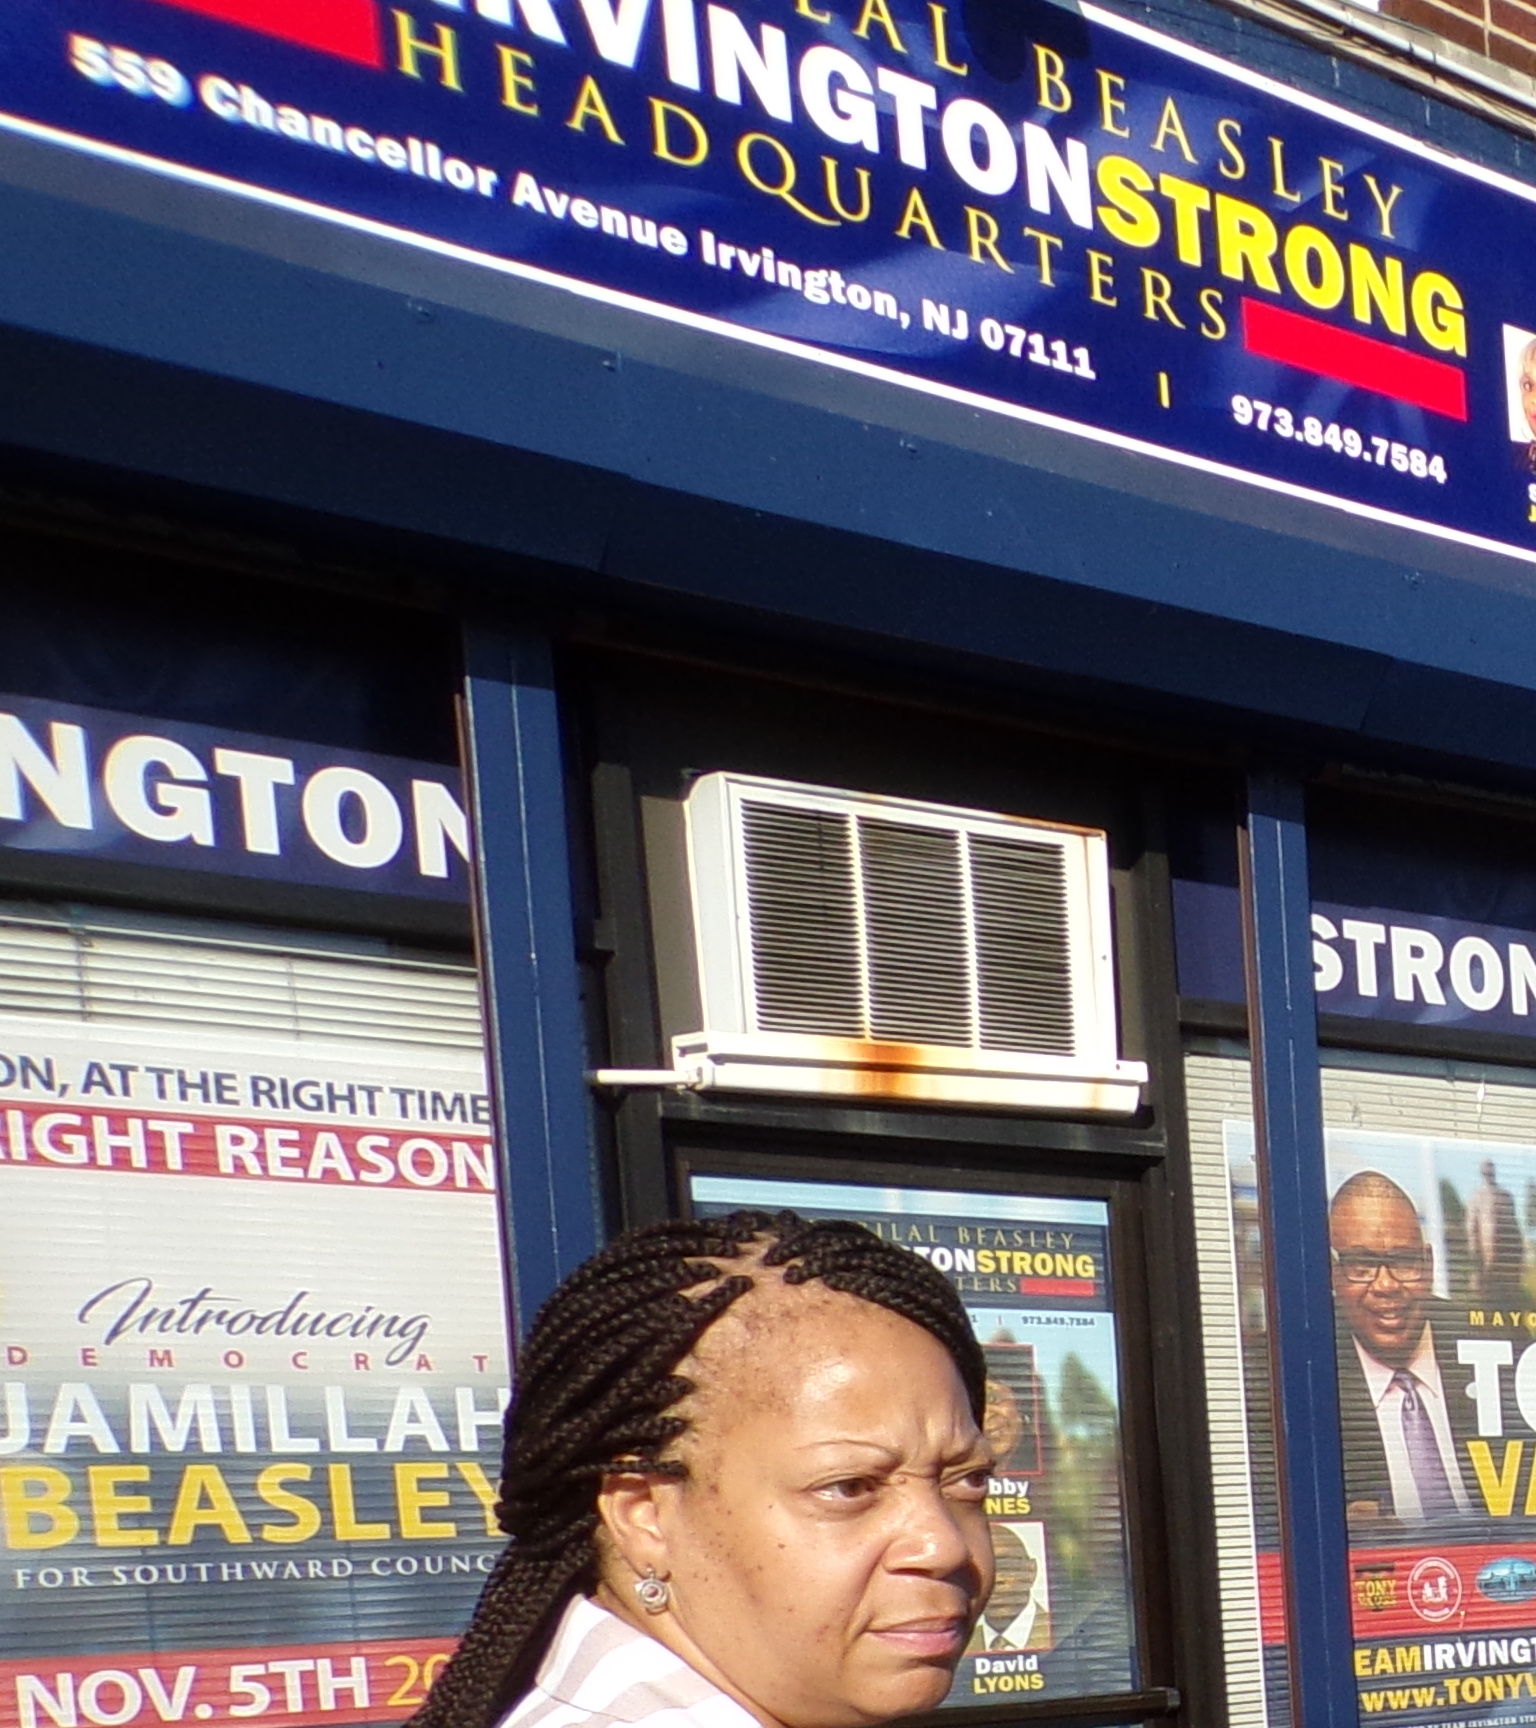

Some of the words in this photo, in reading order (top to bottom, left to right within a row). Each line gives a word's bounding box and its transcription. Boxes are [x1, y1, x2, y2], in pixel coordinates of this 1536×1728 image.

[795, 0, 968, 76] AL
[1032, 43, 1404, 240] BEASLEY
[391, 7, 1228, 341] HEADQUARTERS
[432, 0, 1468, 358] VINGTONSTRONG
[67, 31, 193, 110] 559
[199, 72, 499, 199] Chancellor
[511, 171, 689, 257] Avenue
[701, 229, 911, 329] Irvington,
[922, 297, 970, 341] NJ
[980, 316, 1097, 381] 07111
[1231, 394, 1448, 485] 973.849.7584
[81, 1060, 137, 1098] AT
[144, 1065, 240, 1107] THE
[250, 1073, 391, 1117] RIGHT
[389, 1087, 491, 1126] TIME
[0, 1107, 195, 1172] IGHT
[214, 1122, 495, 1191] REASON
[902, 1245, 1096, 1279] ONSTRONG
[957, 1225, 1075, 1250] BEASLEY
[78, 1276, 434, 1367] Introducing
[7, 1345, 490, 1374] DEMOCRAT
[0, 1381, 511, 1455] JAMILLAH
[1, 1461, 508, 1550] BEASLEY
[15, 1565, 96, 1589] FOR
[112, 1556, 354, 1588] SOUTHWARD
[228, 1655, 371, 1718] 5TH
[973, 1672, 1044, 1695] LYONS
[974, 1654, 1039, 1675] David
